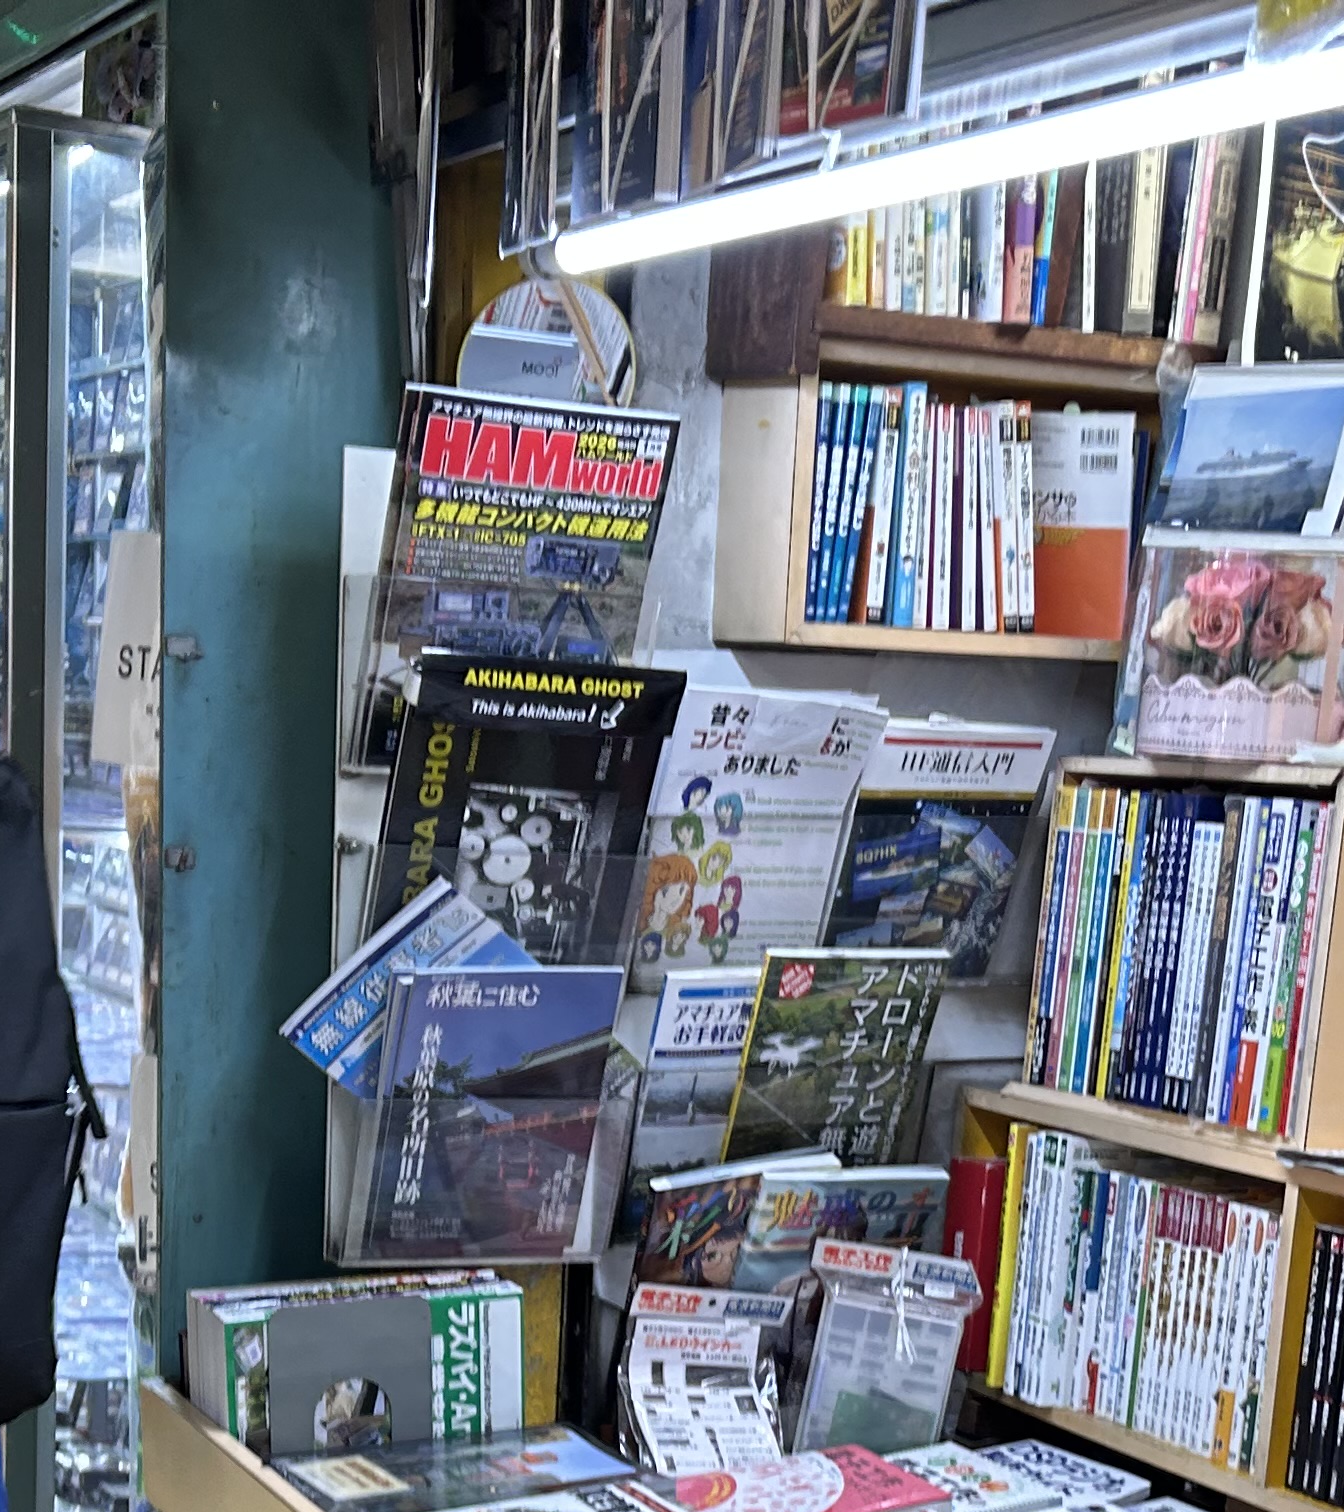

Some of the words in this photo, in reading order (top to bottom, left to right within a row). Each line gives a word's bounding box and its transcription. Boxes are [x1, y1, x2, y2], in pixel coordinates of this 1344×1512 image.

[419, 412, 579, 492] HAM
[569, 457, 665, 501] world
[464, 667, 578, 697] AKIHABARA
[581, 678, 646, 701] GHOST
[471, 697, 499, 717] This
[723, 753, 802, 778] ありました
